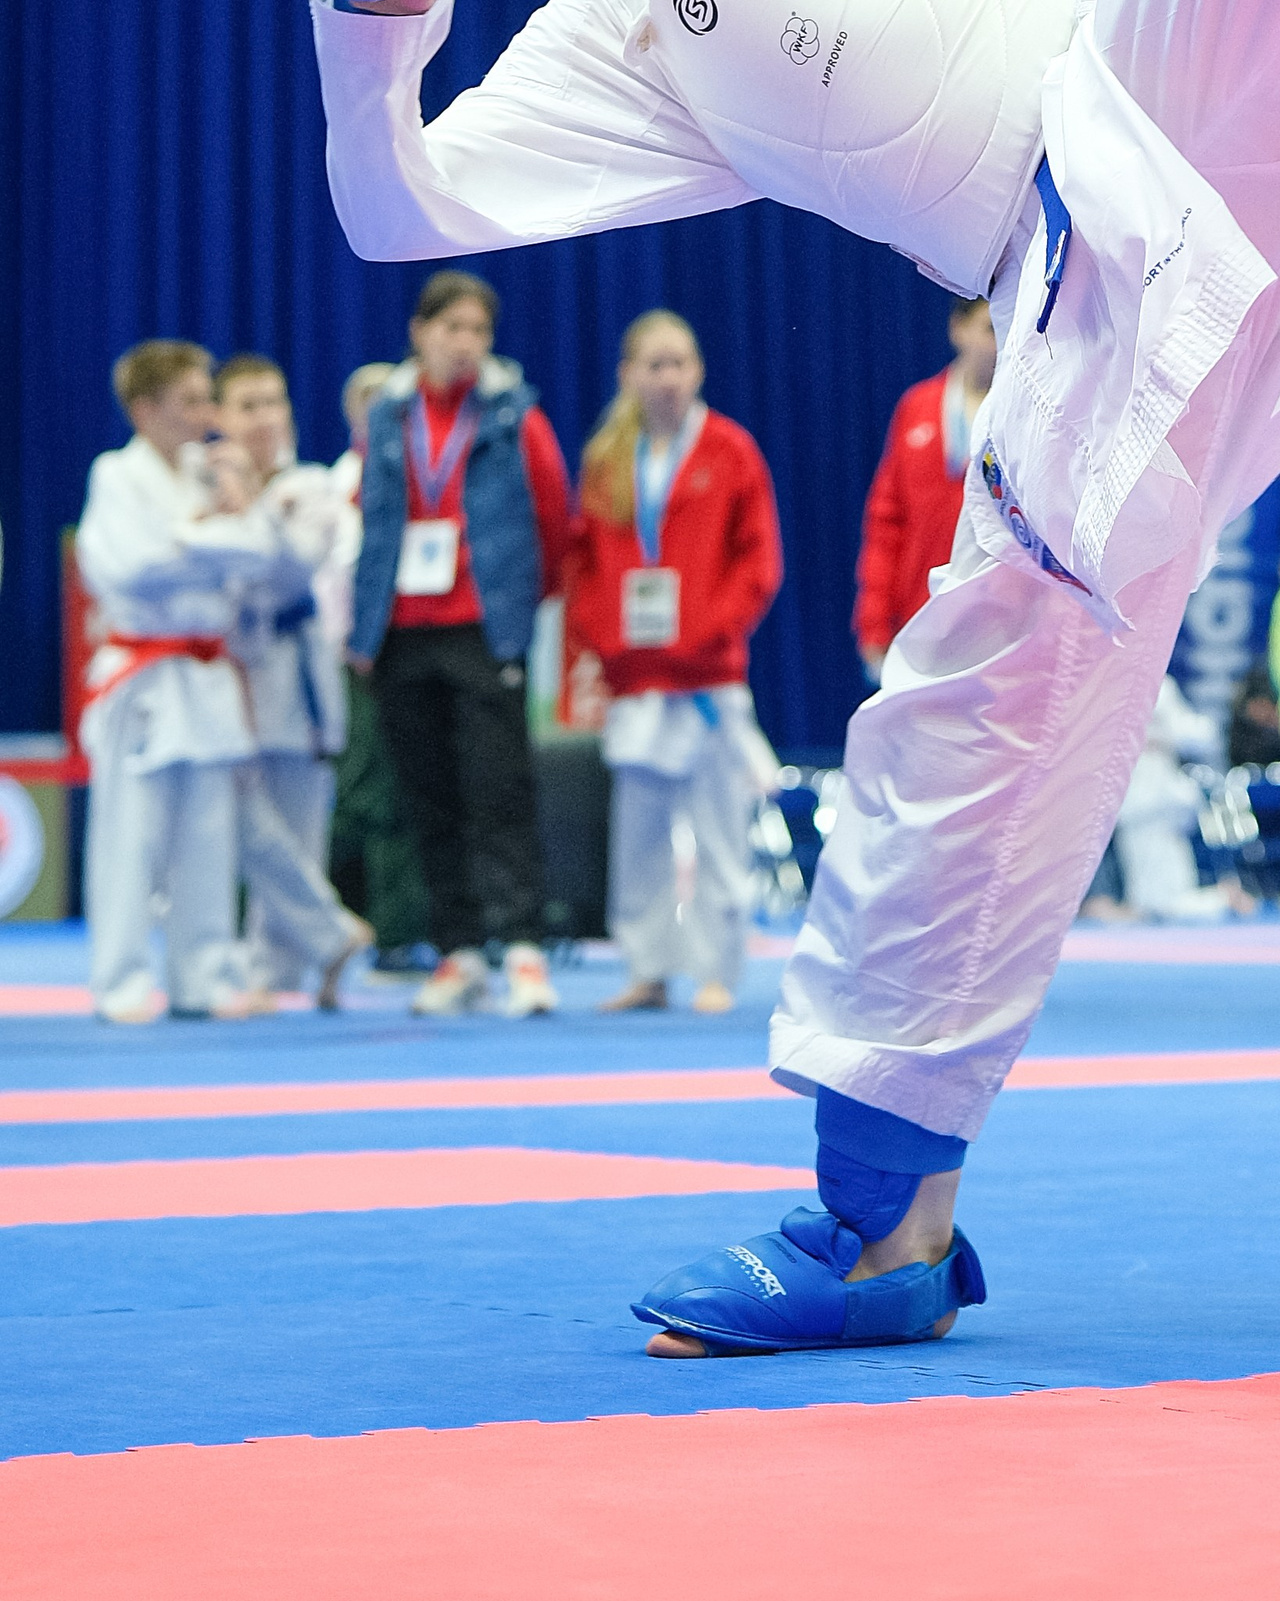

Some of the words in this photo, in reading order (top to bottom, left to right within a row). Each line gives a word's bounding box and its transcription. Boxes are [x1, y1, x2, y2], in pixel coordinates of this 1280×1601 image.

[792, 26, 808, 53] WKF
[821, 31, 848, 88] APPROVED
[1142, 261, 1164, 292] ORT
